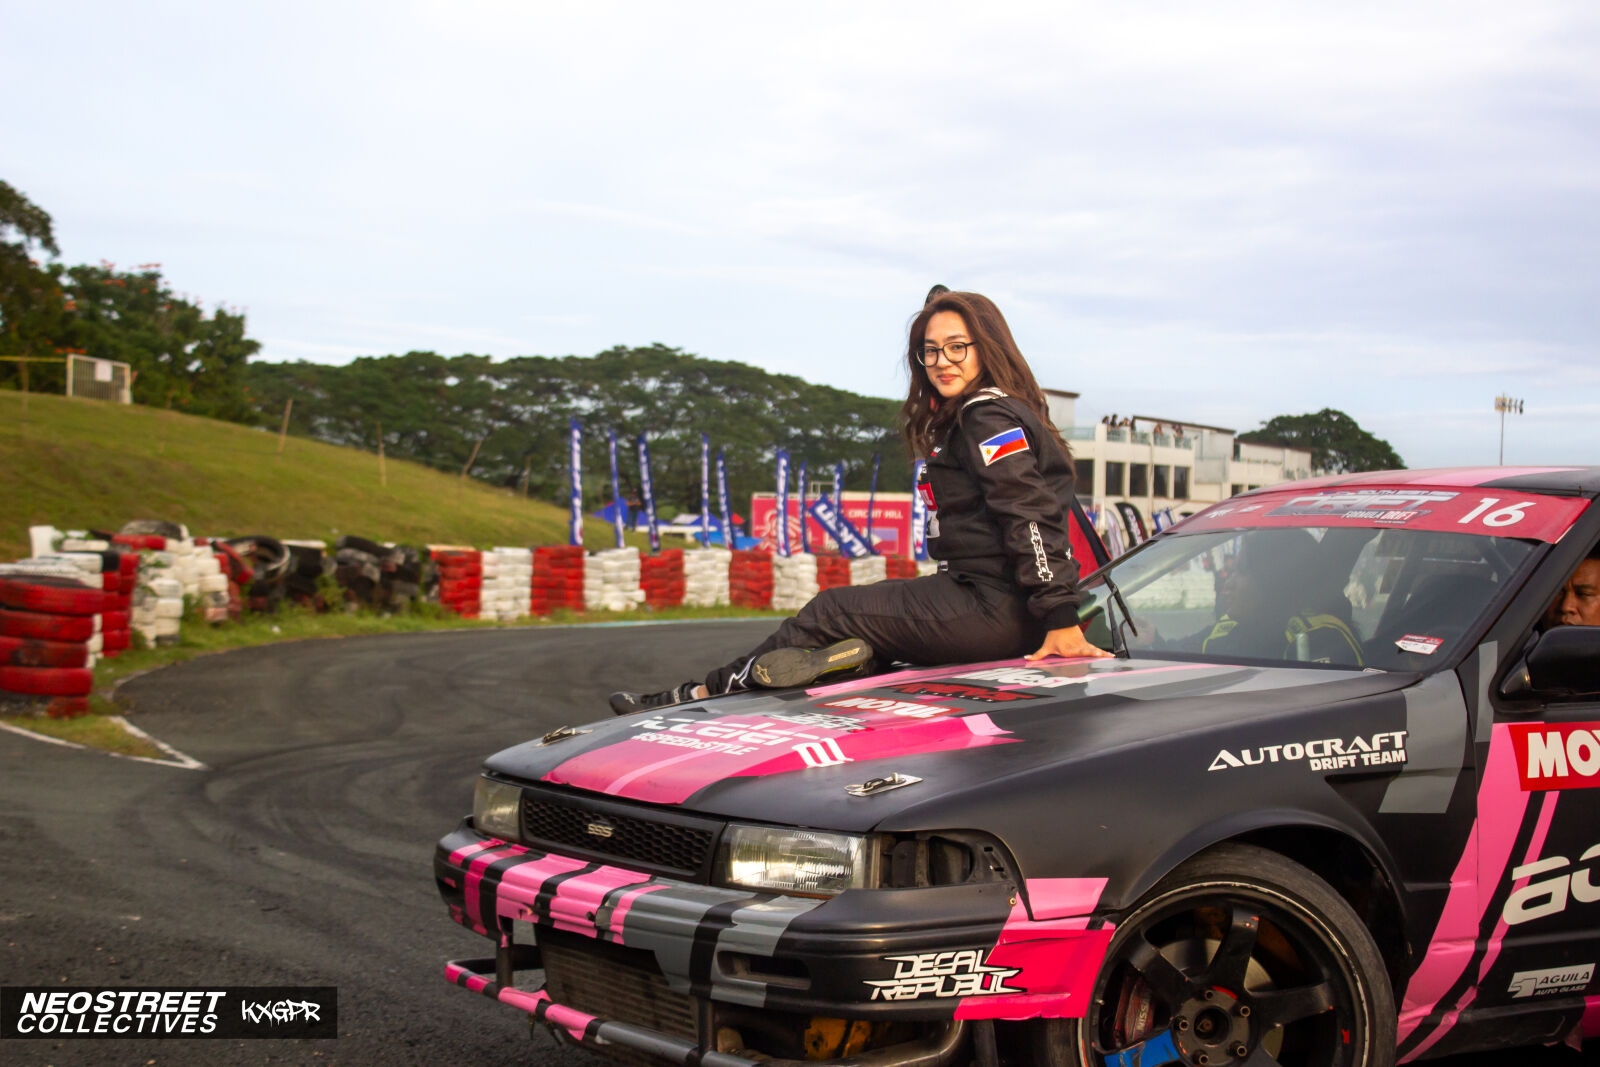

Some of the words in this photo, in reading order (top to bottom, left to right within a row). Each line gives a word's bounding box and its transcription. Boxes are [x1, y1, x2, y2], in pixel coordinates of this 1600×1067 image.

[1457, 497, 1536, 528] 16
[824, 697, 952, 719] MOTUL
[1207, 731, 1407, 771] AUTOCRAFT
[1309, 755, 1357, 771] DRIFT
[1361, 751, 1407, 766] TEAM
[1527, 729, 1600, 777] MO
[884, 949, 1009, 979] DECAL
[1539, 971, 1590, 985] AGUILA
[863, 969, 1024, 1001] REPUBLIC
[1534, 987, 1558, 996] AUTO
[1560, 984, 1587, 993] GLASS
